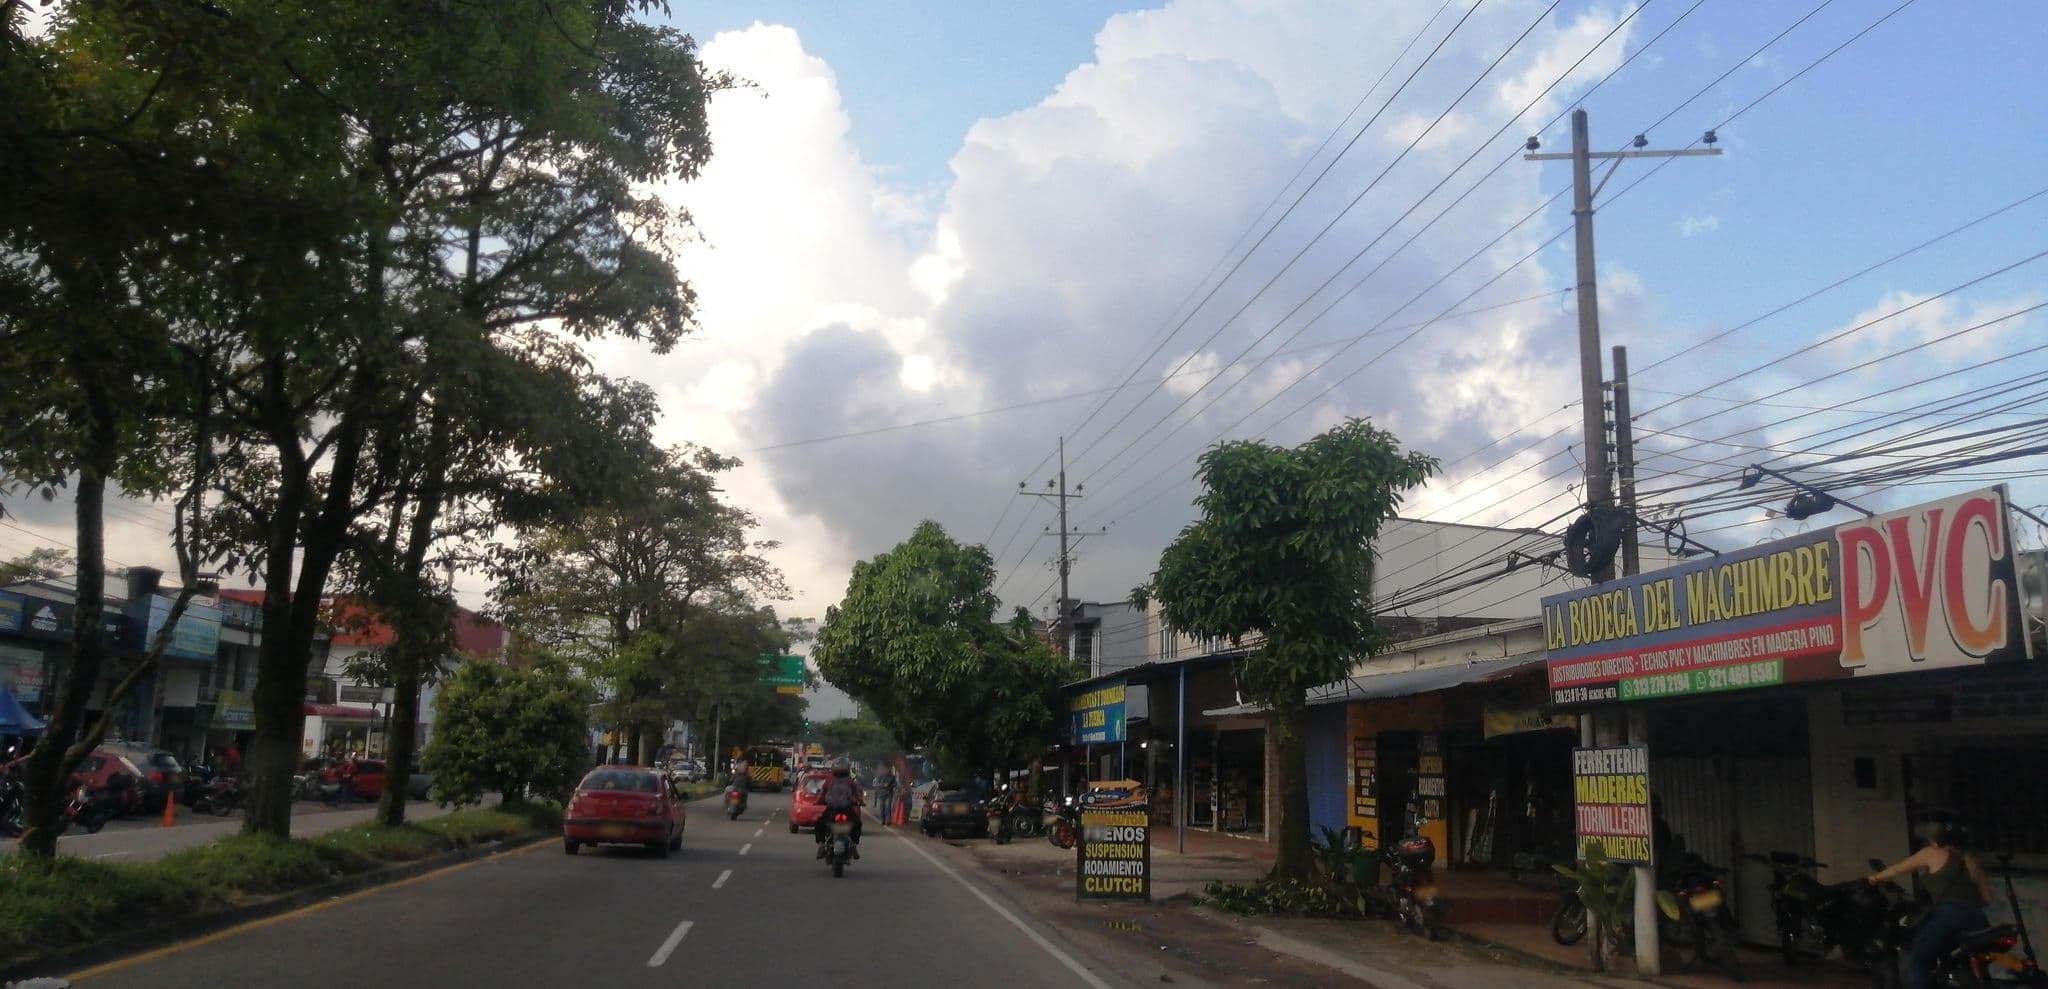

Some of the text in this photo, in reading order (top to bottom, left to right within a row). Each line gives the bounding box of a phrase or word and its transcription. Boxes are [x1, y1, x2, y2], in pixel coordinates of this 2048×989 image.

[1837, 495, 2004, 664] PVC
[1545, 541, 1832, 650] LA BODEGA DEL MACHIMBRE
[1552, 659, 1601, 682] DISTRIBUIDORES
[1602, 655, 1635, 676] DIRECTOS
[1639, 650, 1669, 671] TECHOS
[1669, 648, 1685, 668] PVC
[1685, 647, 1691, 665] Y
[1692, 638, 1752, 665] MACHIMBRES
[1752, 635, 1765, 656] EN
[1766, 629, 1808, 654] MADERA
[1808, 624, 1835, 647] PINO
[1575, 748, 1646, 774] FERRETERIA
[1576, 774, 1648, 805] MADERAS
[1578, 805, 1649, 835] TORNILLERIA
[1084, 827, 1145, 842] ENOS
[1579, 835, 1649, 862] HAMIENTAS
[1084, 860, 1143, 875] RODAMIENTO
[1085, 878, 1142, 893] CLUTCH
